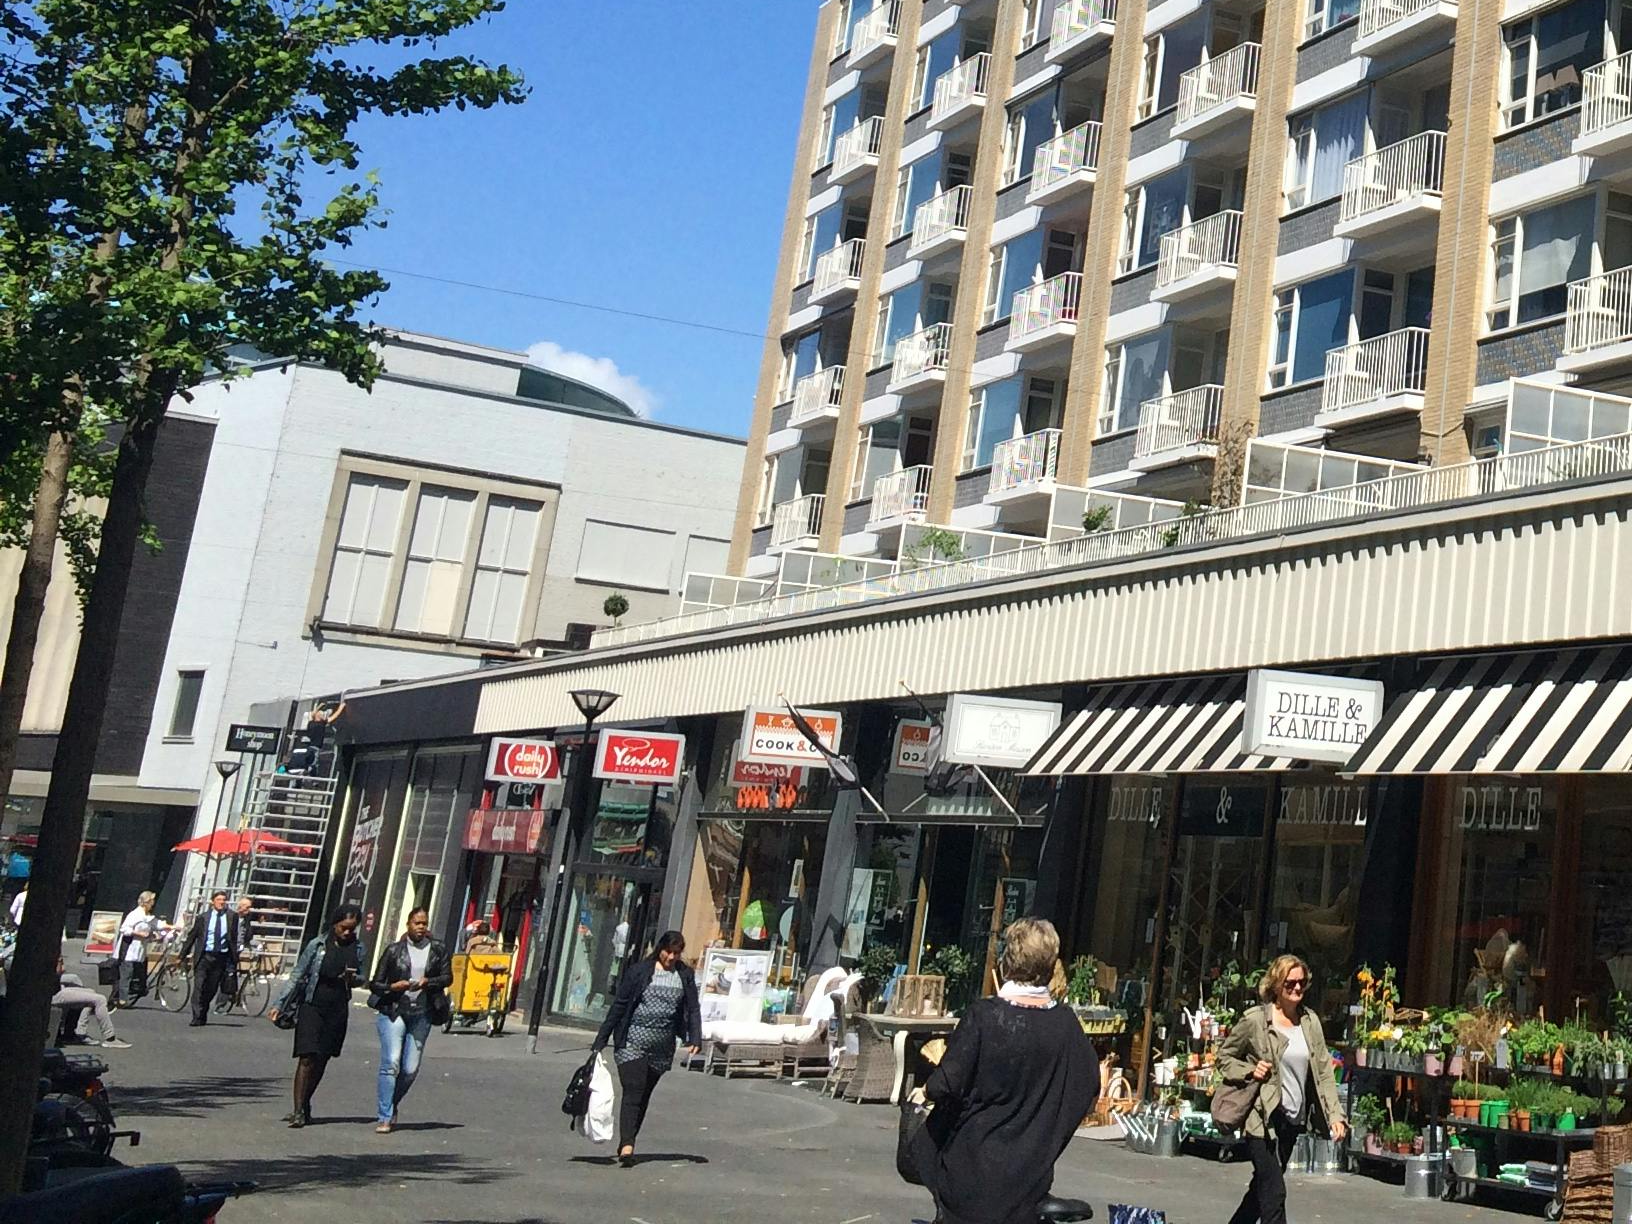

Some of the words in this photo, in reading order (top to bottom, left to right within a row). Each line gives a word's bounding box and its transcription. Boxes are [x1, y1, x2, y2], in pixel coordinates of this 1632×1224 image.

[1277, 691, 1340, 719] DILLE
[1345, 698, 1363, 720] &
[1267, 715, 1367, 744] KAMILLE
[515, 745, 545, 769] daily
[613, 746, 670, 769] Yendor
[755, 738, 818, 753] COOK&C
[513, 763, 540, 775] rush
[1108, 787, 1163, 824] DILLE
[1216, 786, 1233, 824] &
[1277, 786, 1368, 826] KAMILL
[1458, 786, 1542, 831] DILLE
